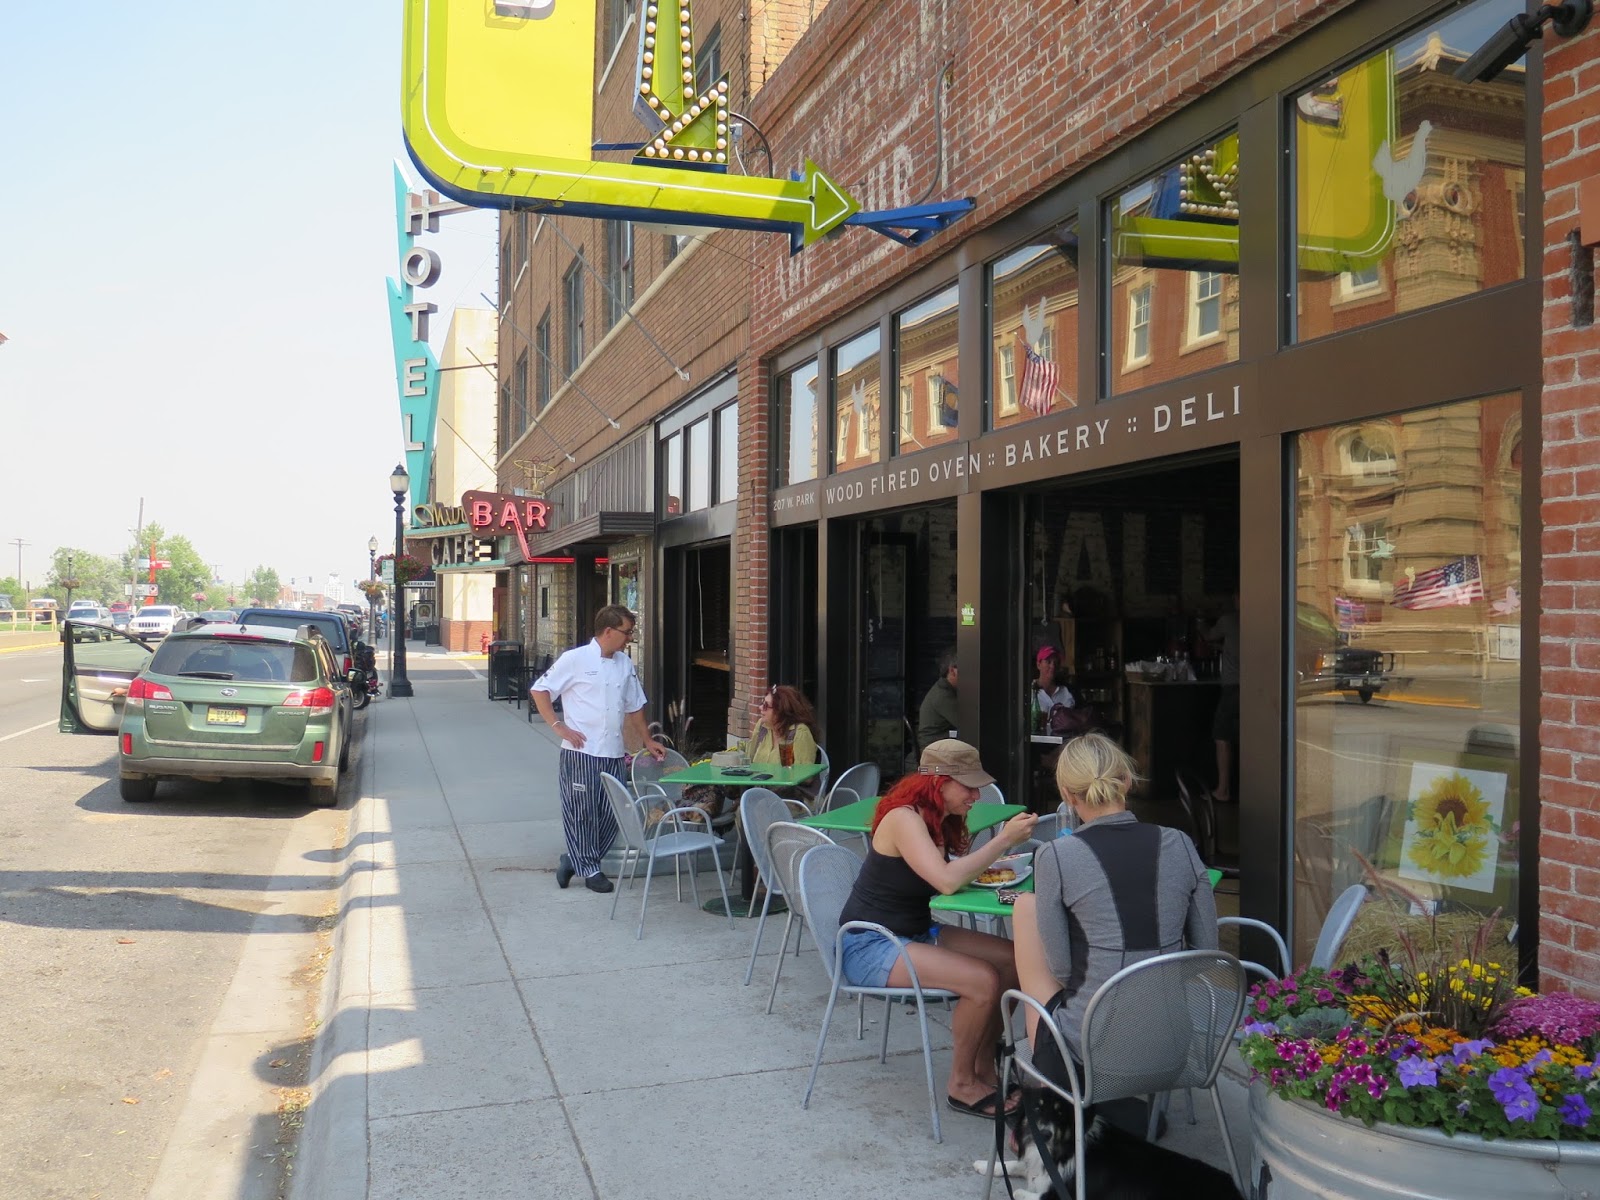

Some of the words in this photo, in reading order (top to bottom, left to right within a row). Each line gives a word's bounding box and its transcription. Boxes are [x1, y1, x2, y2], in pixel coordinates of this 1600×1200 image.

[401, 189, 441, 451] HOTEL
[826, 481, 864, 504] WOOD
[871, 468, 919, 495] FIRED
[929, 452, 981, 482] OVEN
[1005, 419, 1109, 466] BAKERY
[1154, 385, 1240, 433] DELI
[473, 501, 546, 527] BAR
[773, 499, 786, 511] 207
[796, 492, 815, 507] PARK
[431, 534, 479, 566] CAFE
